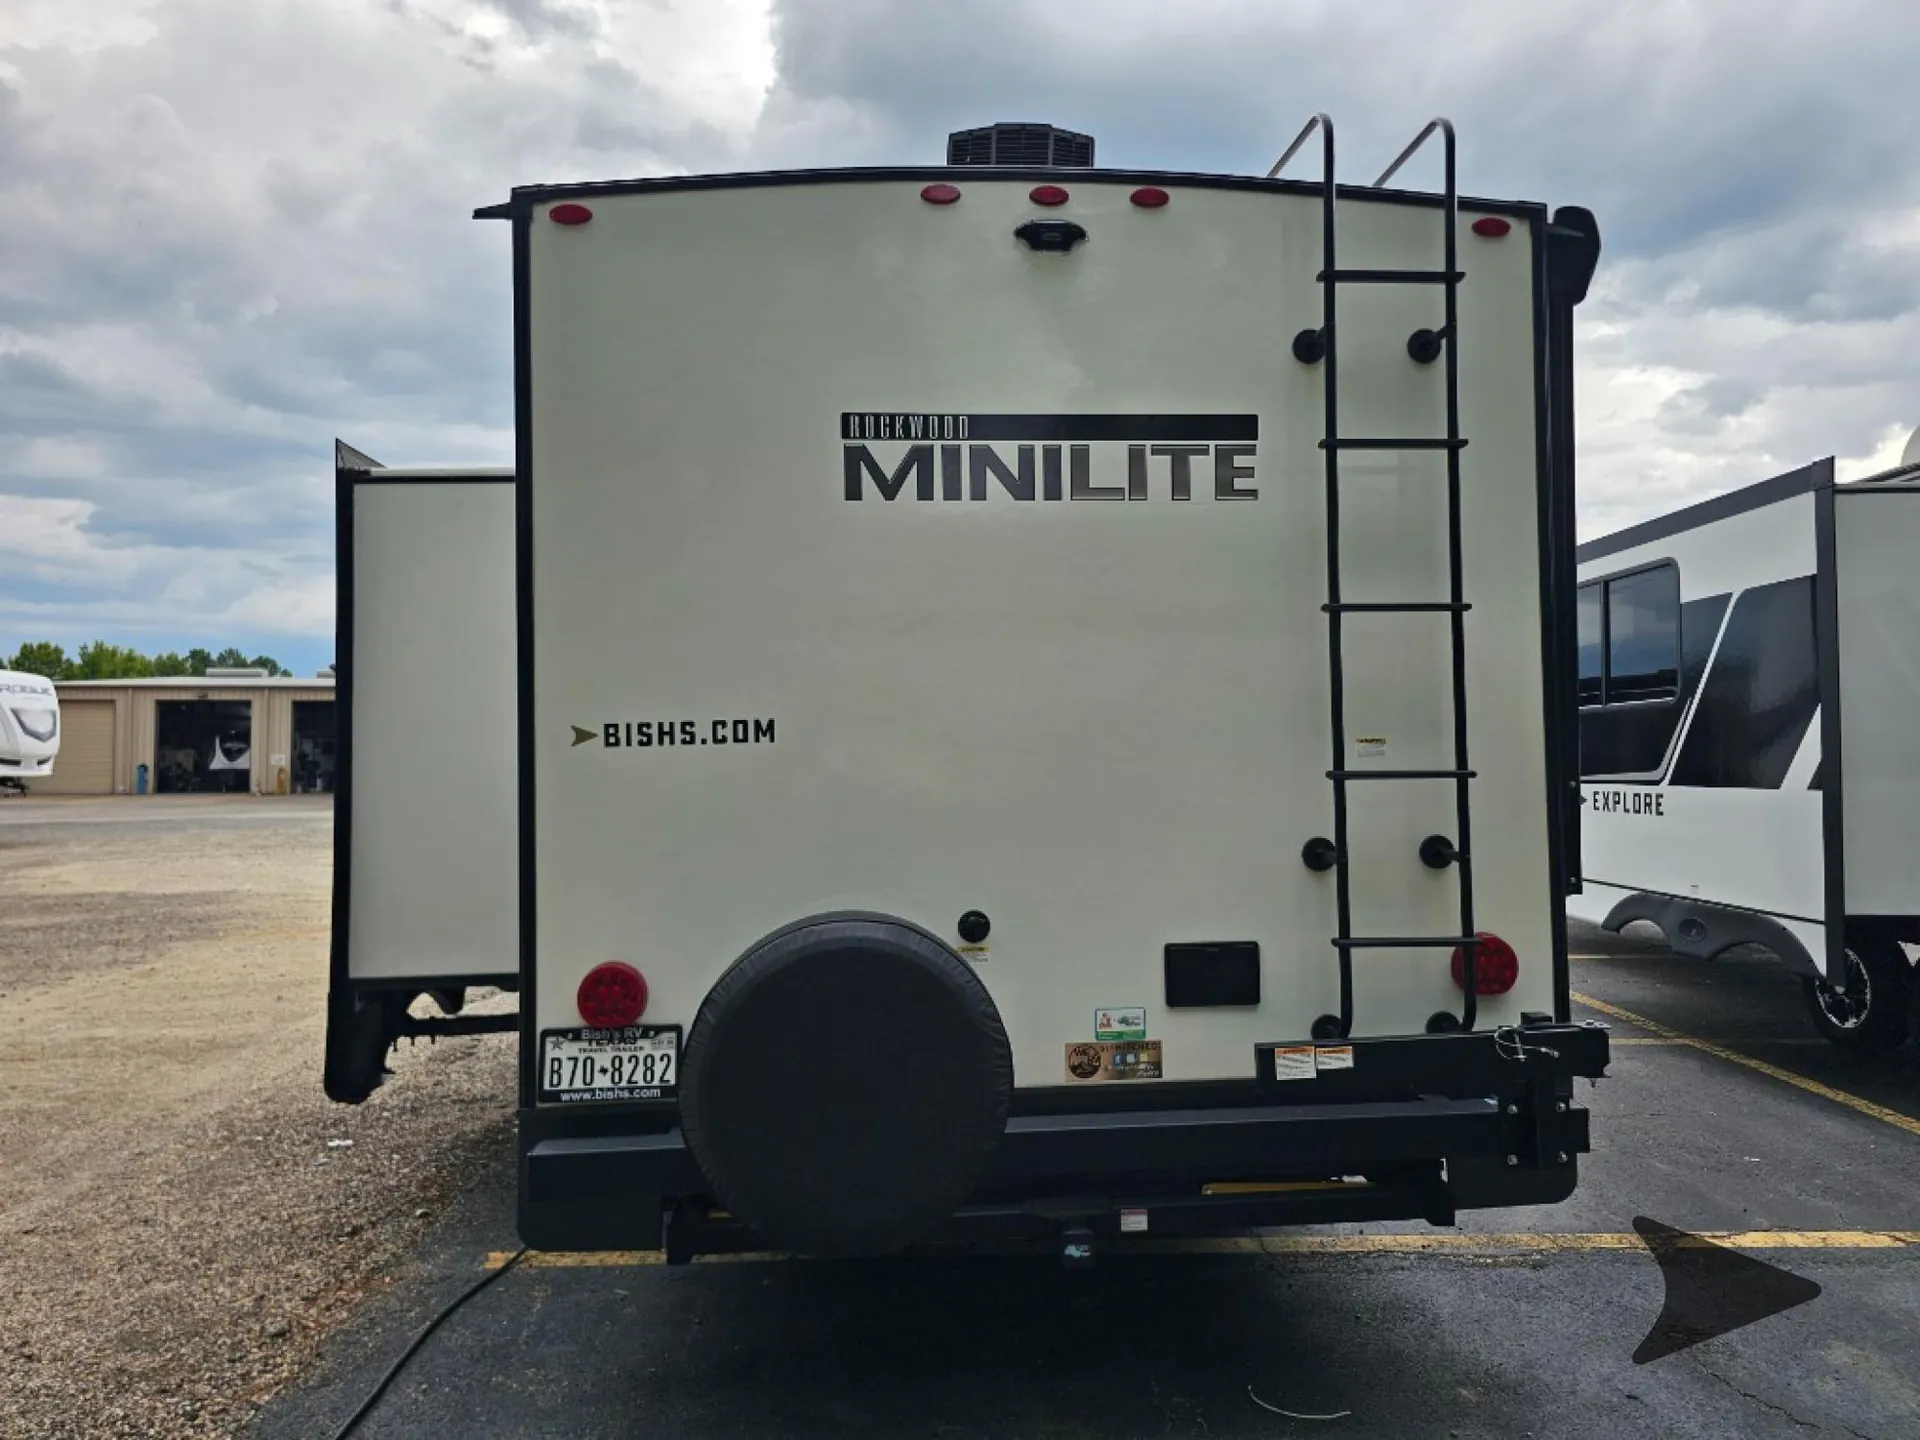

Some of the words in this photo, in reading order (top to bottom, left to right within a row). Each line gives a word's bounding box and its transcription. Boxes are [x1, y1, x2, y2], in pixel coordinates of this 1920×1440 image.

[850, 415, 968, 440] ROCKWOOD
[843, 444, 1259, 501] MINILITE
[603, 718, 775, 747] BISHS.COM
[1593, 791, 1664, 816] EXPLORE
[624, 1026, 643, 1038] RV
[560, 1088, 661, 1102] www.bishs.com
